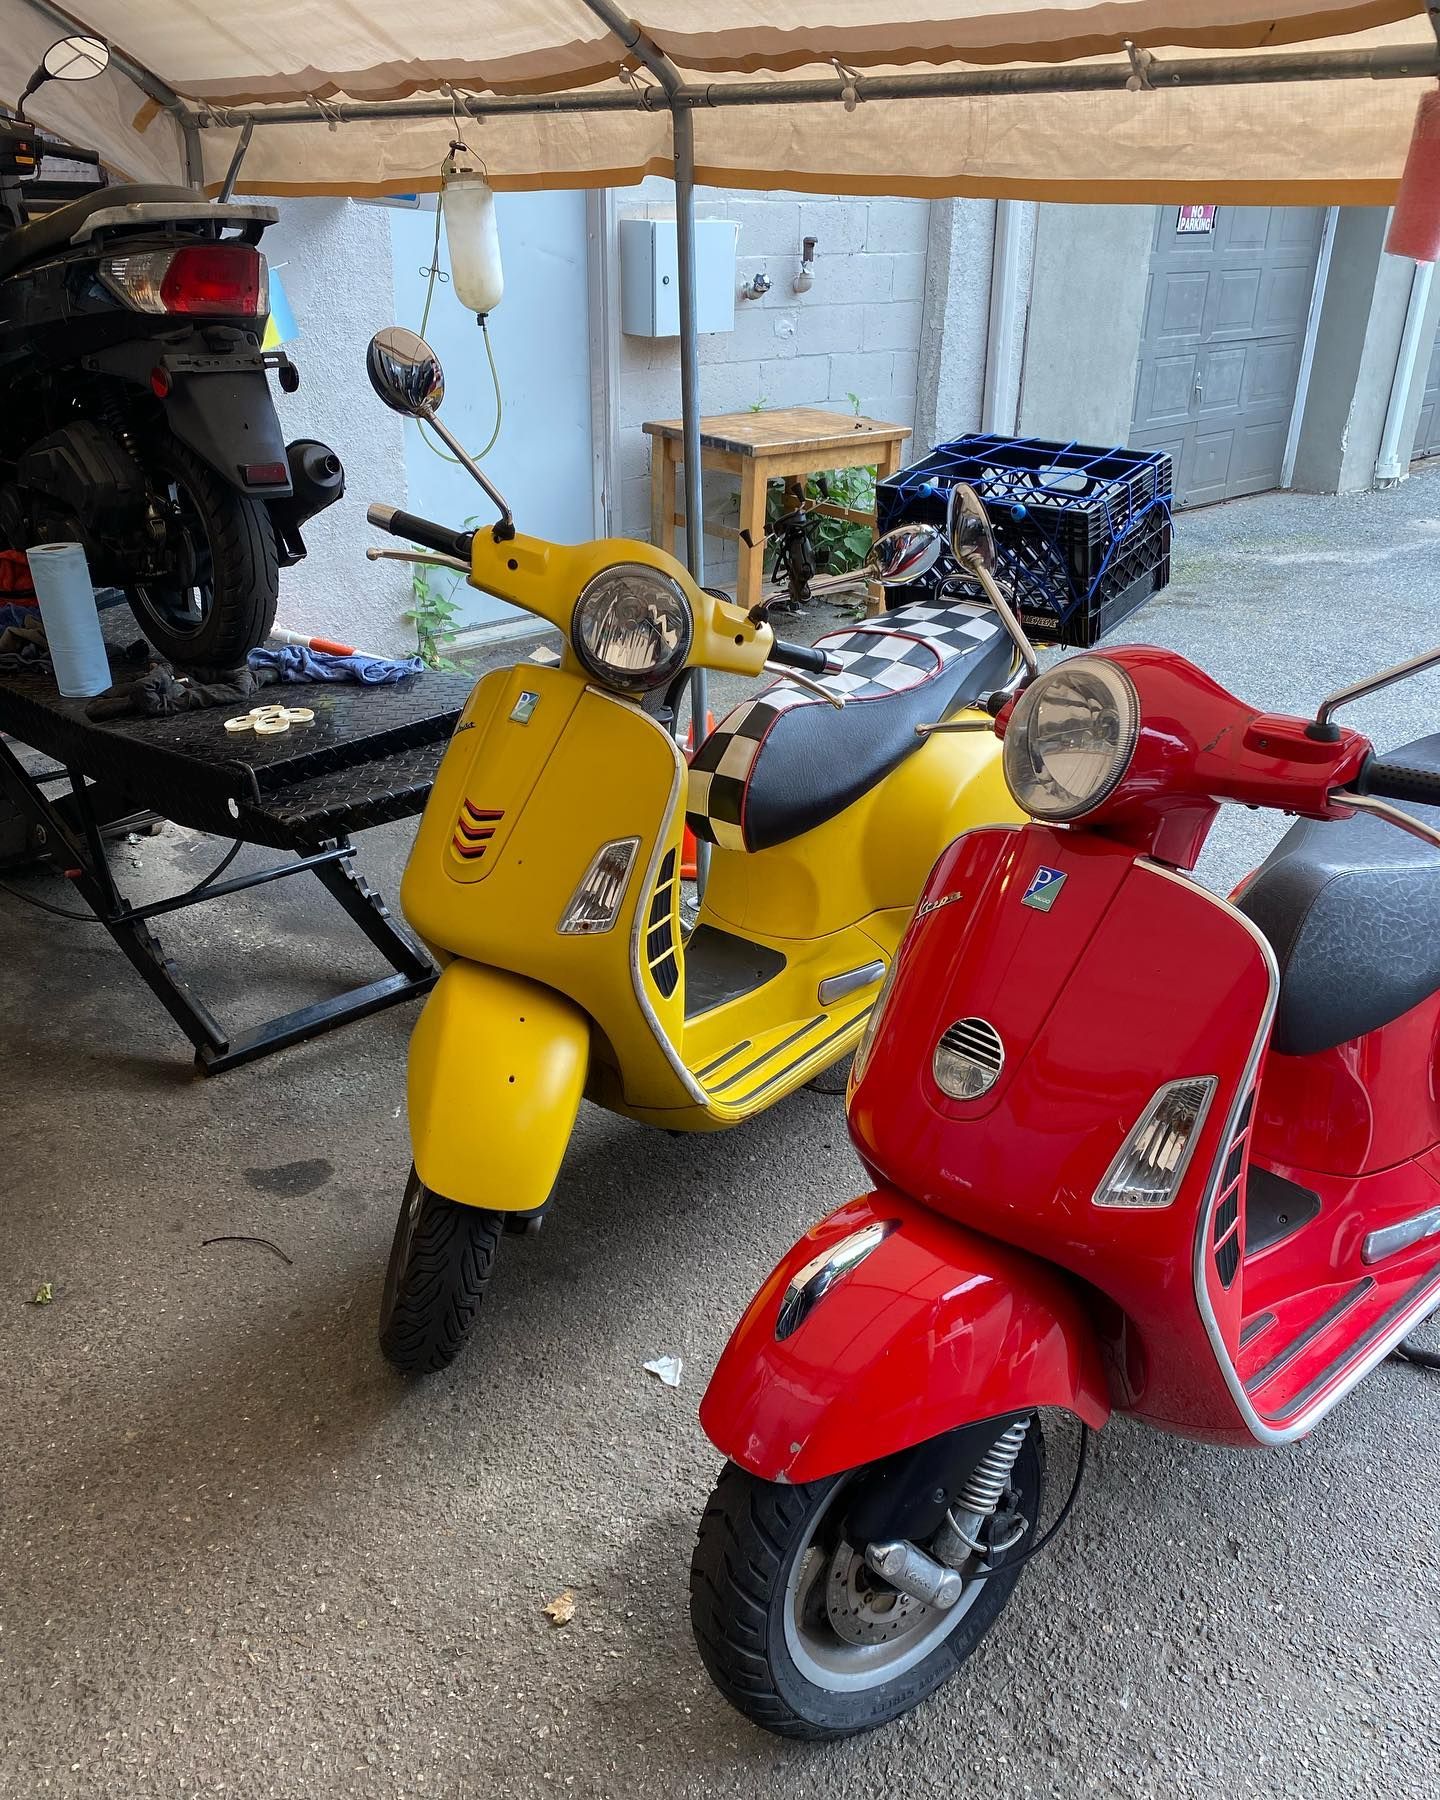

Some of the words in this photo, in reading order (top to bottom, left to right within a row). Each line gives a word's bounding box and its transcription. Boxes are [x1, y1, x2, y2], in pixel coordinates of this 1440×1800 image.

[1191, 205, 1204, 217] NO
[1180, 217, 1210, 230] PARKING
[514, 692, 531, 711] P
[1029, 868, 1052, 892] P
